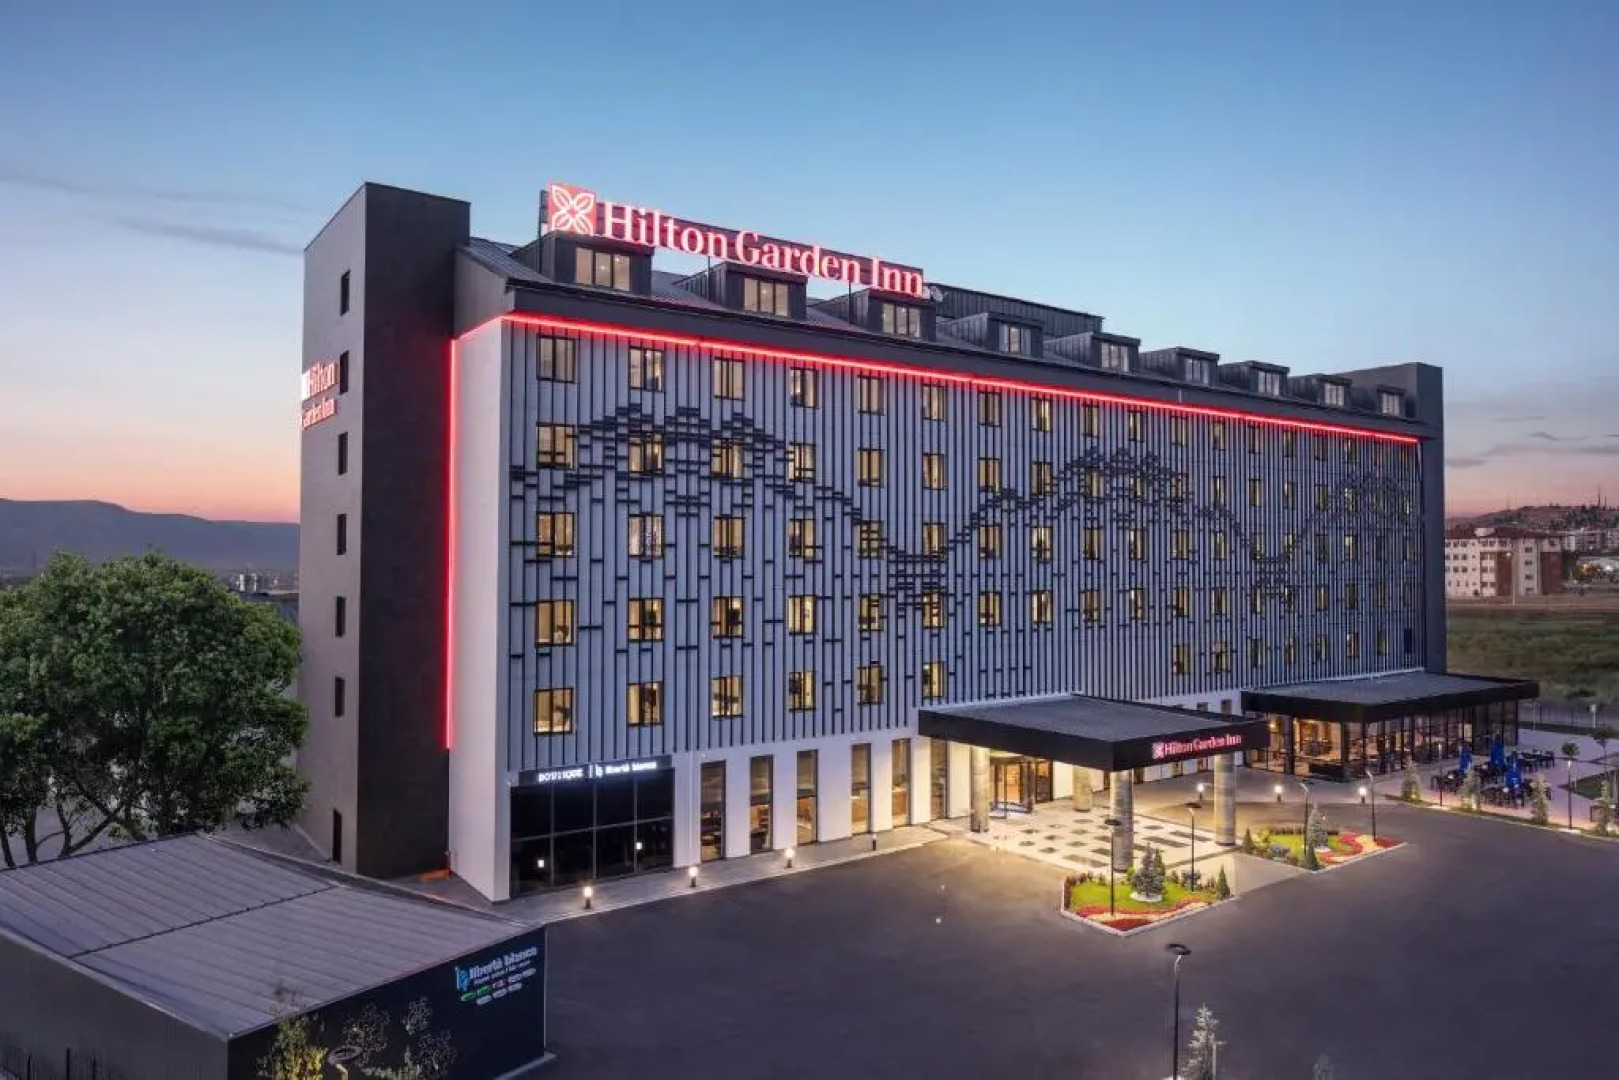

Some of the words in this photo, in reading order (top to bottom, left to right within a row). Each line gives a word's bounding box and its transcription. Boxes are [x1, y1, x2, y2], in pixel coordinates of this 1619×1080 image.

[603, 201, 727, 258] Hilton
[735, 231, 861, 283] Garden
[870, 258, 923, 297] Inn
[1164, 742, 1193, 756] Hilton
[1226, 734, 1242, 746] Inn
